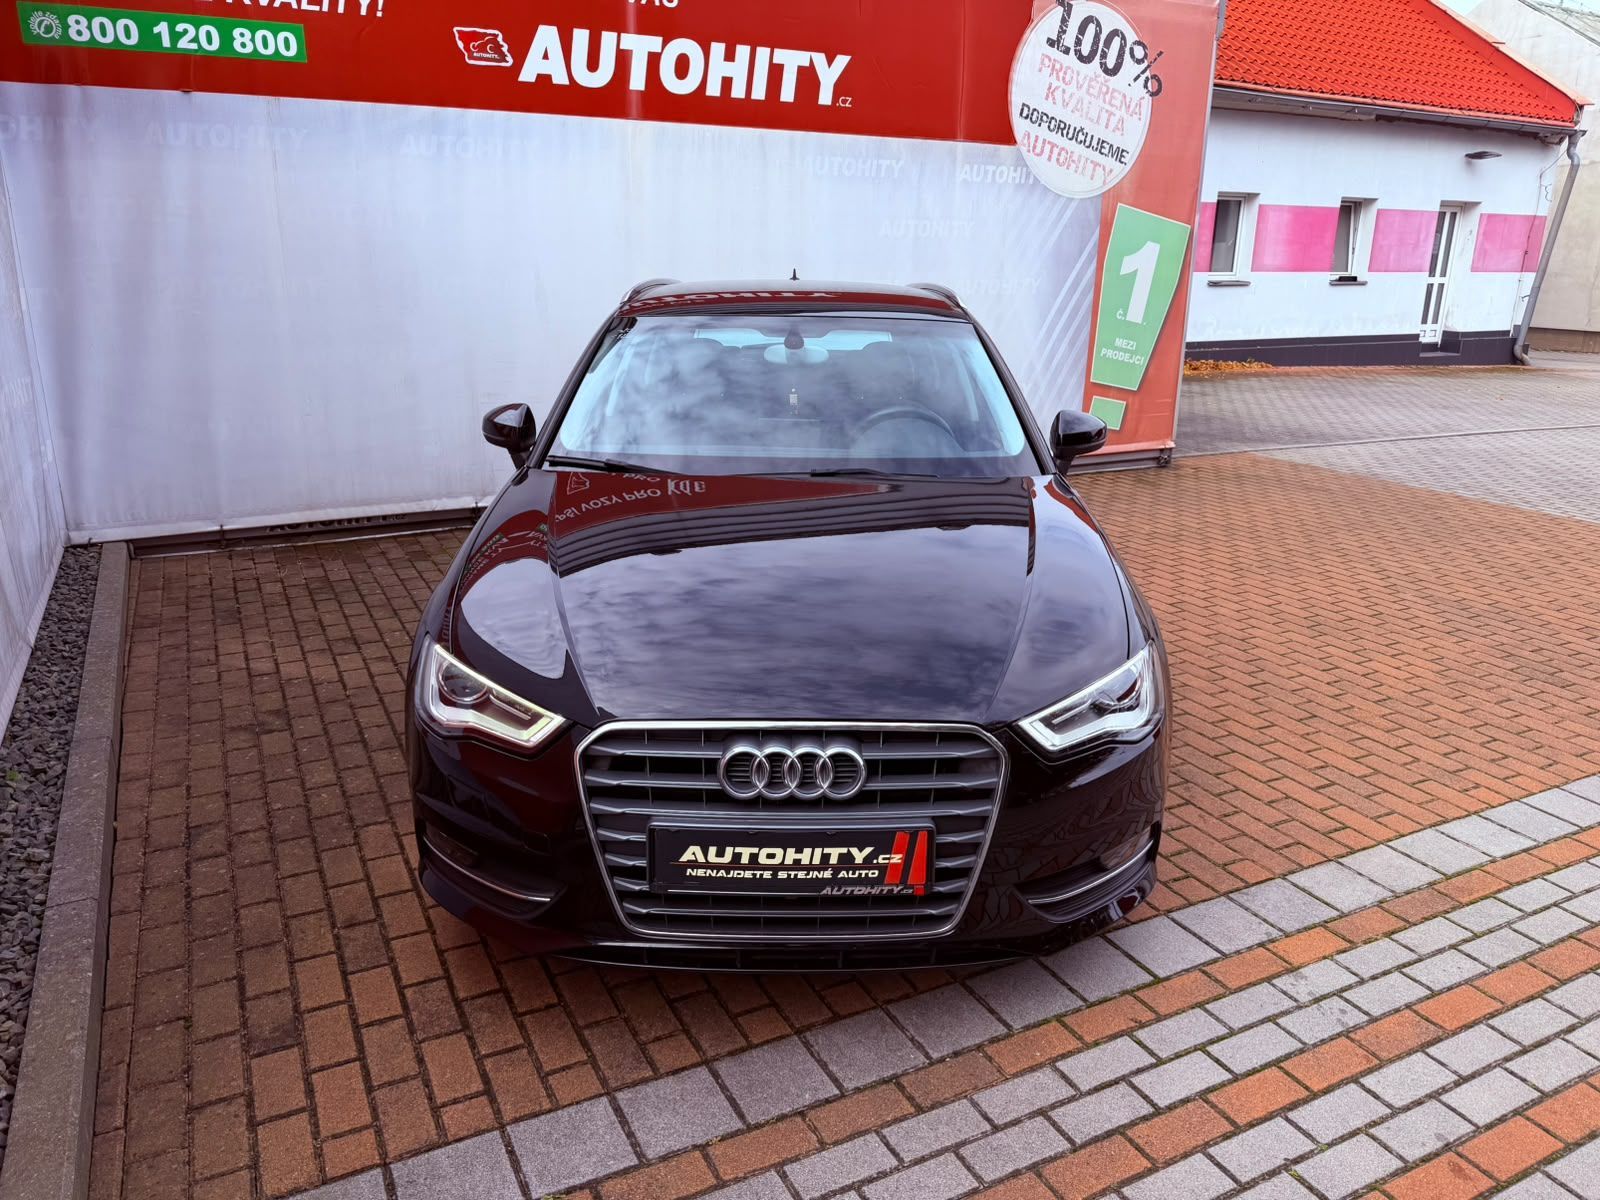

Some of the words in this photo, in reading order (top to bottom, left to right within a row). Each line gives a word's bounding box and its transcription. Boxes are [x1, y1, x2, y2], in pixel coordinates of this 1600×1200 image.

[67, 14, 139, 46] 800
[153, 21, 221, 52] 120
[232, 27, 298, 57] 800
[1047, 0, 1164, 97] 100%
[1037, 53, 1146, 121] PROVĚŘENÁ
[1043, 82, 1125, 136] KVALITA
[1018, 102, 1130, 166] DOPORUČUJEME
[1020, 129, 1114, 185] AUTOHITY
[803, 156, 905, 179] AUTOHITY
[1100, 348, 1145, 366] PRODEJCI
[1114, 337, 1136, 351] MEZI
[686, 868, 773, 879] NENAJDETE
[777, 868, 833, 880] STEJNÉ
[838, 870, 880, 879] AUTO
